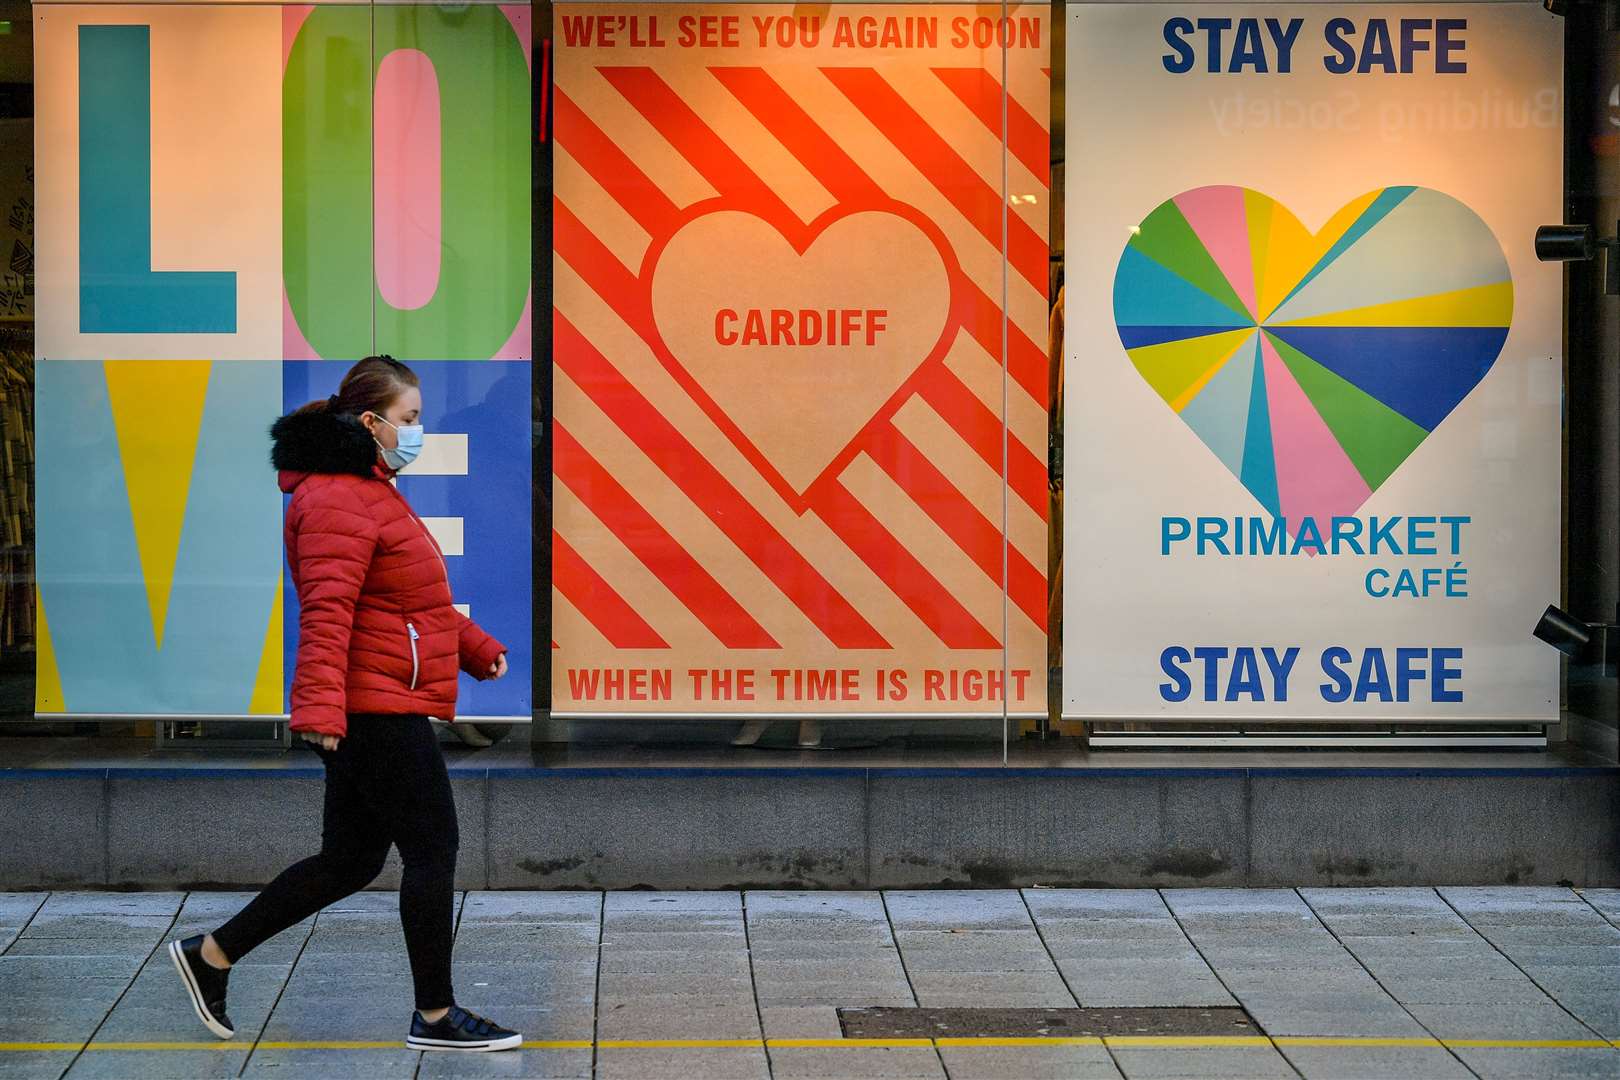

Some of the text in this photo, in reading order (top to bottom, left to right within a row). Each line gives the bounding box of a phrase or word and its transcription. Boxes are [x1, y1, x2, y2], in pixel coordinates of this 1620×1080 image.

[562, 15, 1041, 50] WE'LL SEE YOU AGAIN SOON
[1161, 16, 1468, 75] STAY SAFE
[714, 308, 888, 347] CARDIFF
[1161, 515, 1472, 556] PRIMARKET
[1365, 561, 1469, 598] CAFÉ
[567, 668, 1032, 702] WHEN THE TIME IS RIGHT
[1158, 645, 1464, 703] STAY SAFE
